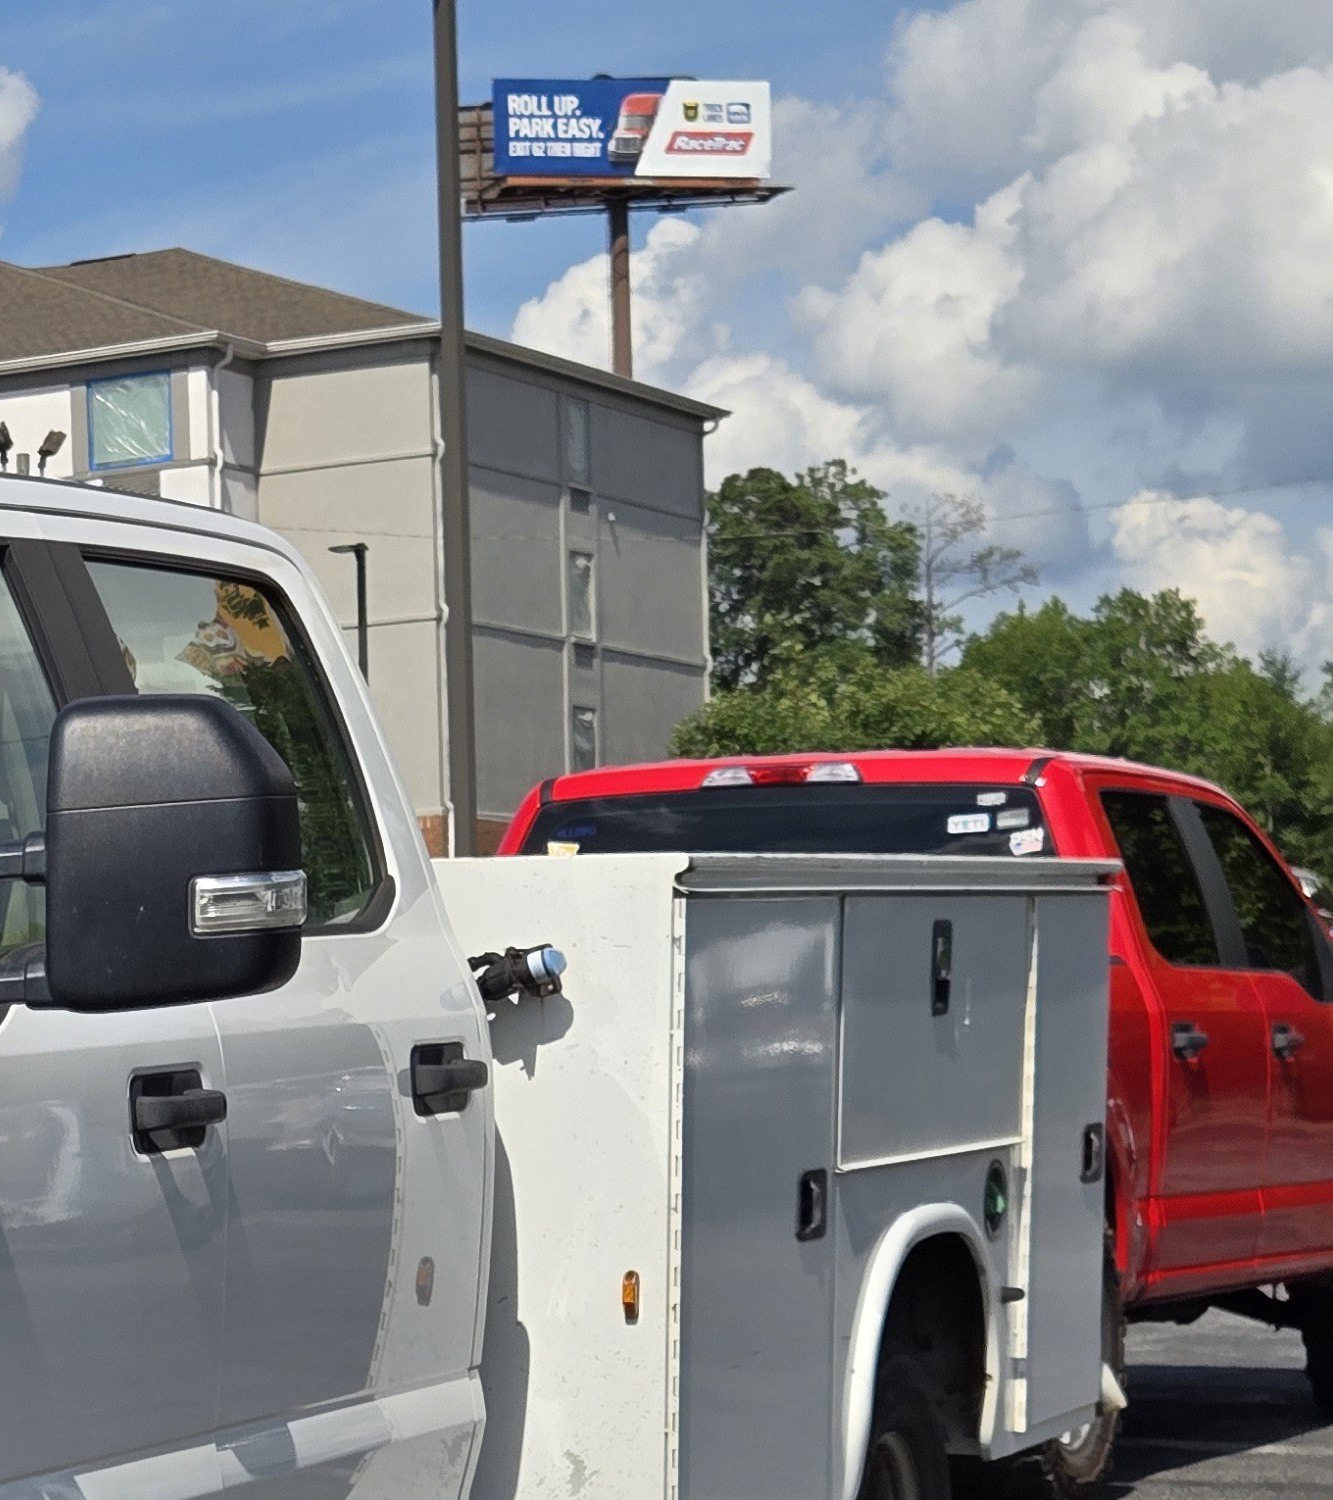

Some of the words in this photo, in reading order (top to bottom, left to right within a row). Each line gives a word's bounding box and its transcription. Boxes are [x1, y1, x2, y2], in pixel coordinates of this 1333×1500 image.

[508, 95, 552, 115] ROLL
[554, 95, 581, 116] UP.
[509, 118, 555, 138] PARK
[557, 118, 605, 138] EASY.
